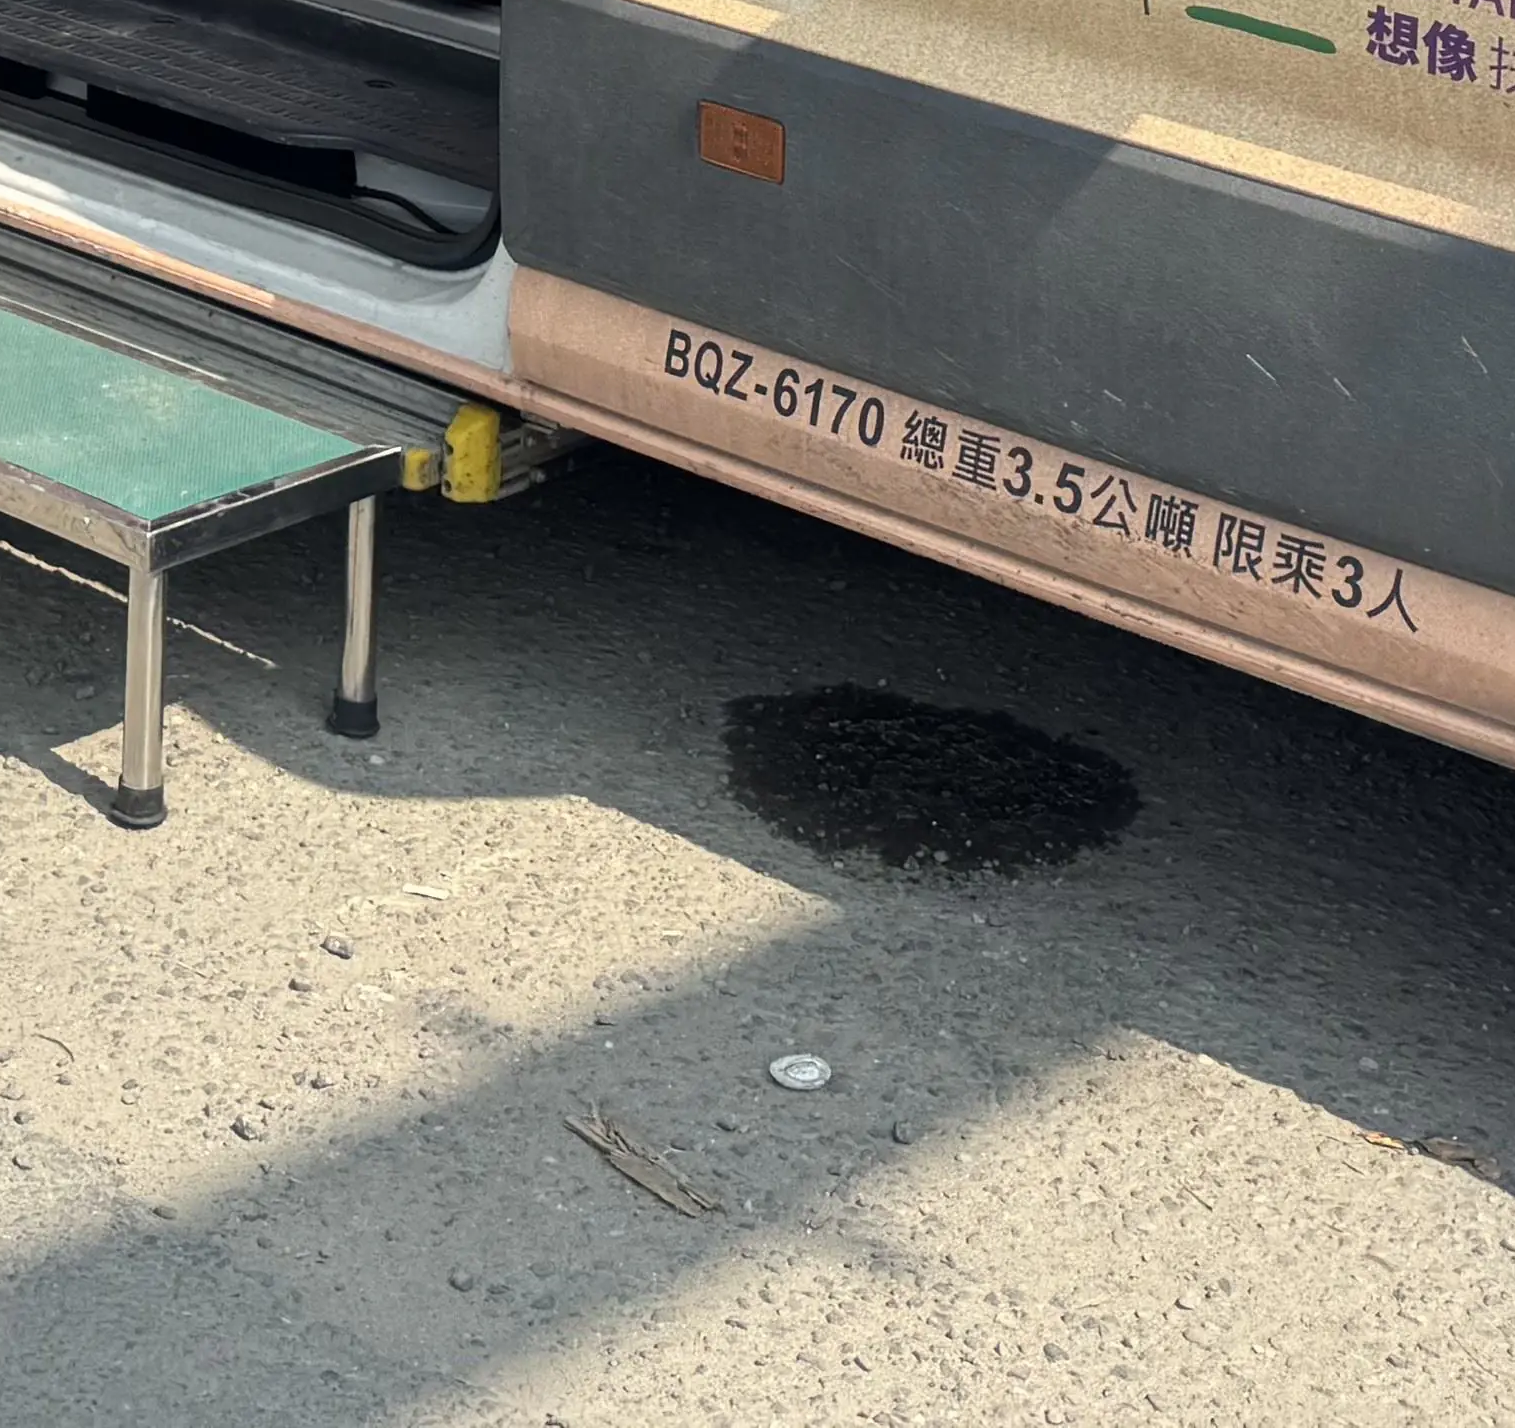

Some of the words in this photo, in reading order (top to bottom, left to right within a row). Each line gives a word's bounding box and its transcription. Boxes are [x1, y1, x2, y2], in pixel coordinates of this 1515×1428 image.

[1365, 5, 1479, 85] 想像
[664, 329, 886, 448] BQZ-6170
[899, 408, 1199, 561] 總重3.5公噸
[1212, 516, 1420, 634] 限乘3人
